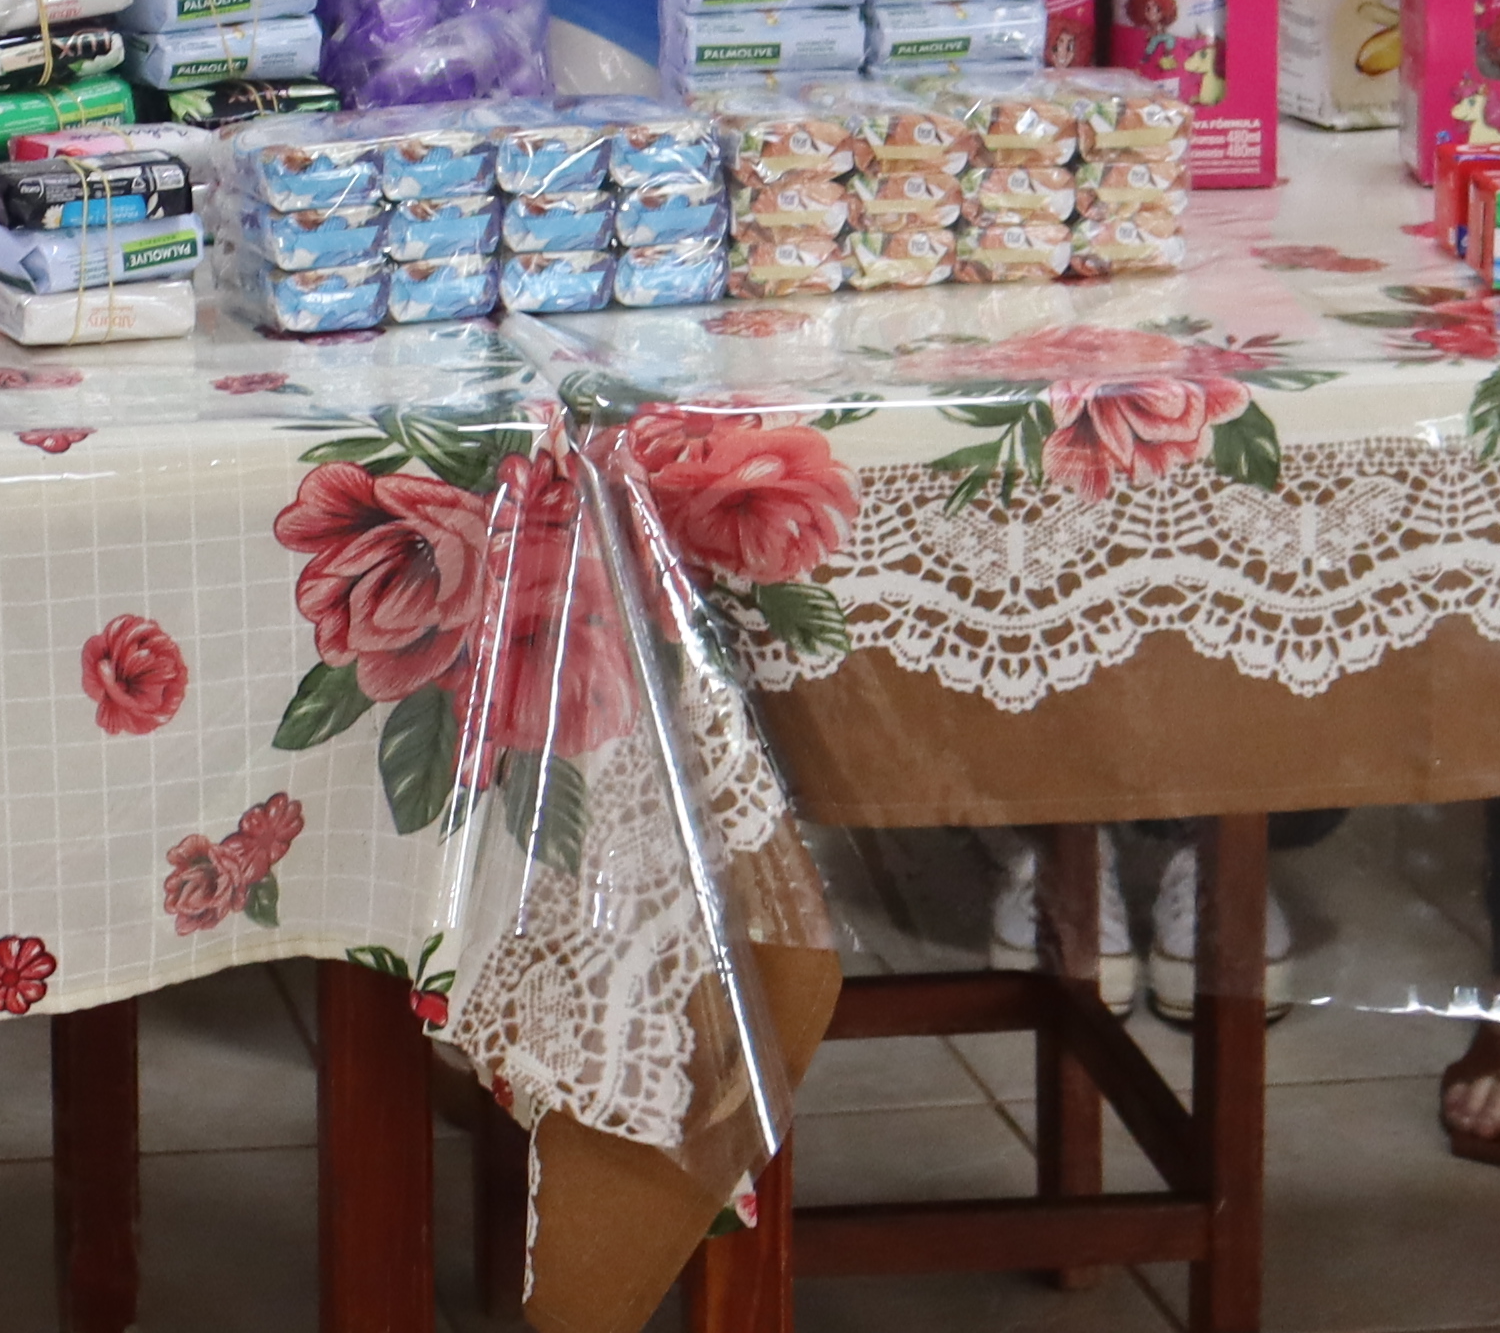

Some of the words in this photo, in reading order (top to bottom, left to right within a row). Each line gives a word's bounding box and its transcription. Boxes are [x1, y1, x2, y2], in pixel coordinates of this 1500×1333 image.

[703, 45, 775, 59] PALMOLIVE
[897, 40, 966, 56] PALMOLIVE
[176, 60, 246, 76] PALMOLIVE
[127, 242, 193, 268] PALMOLIVE
